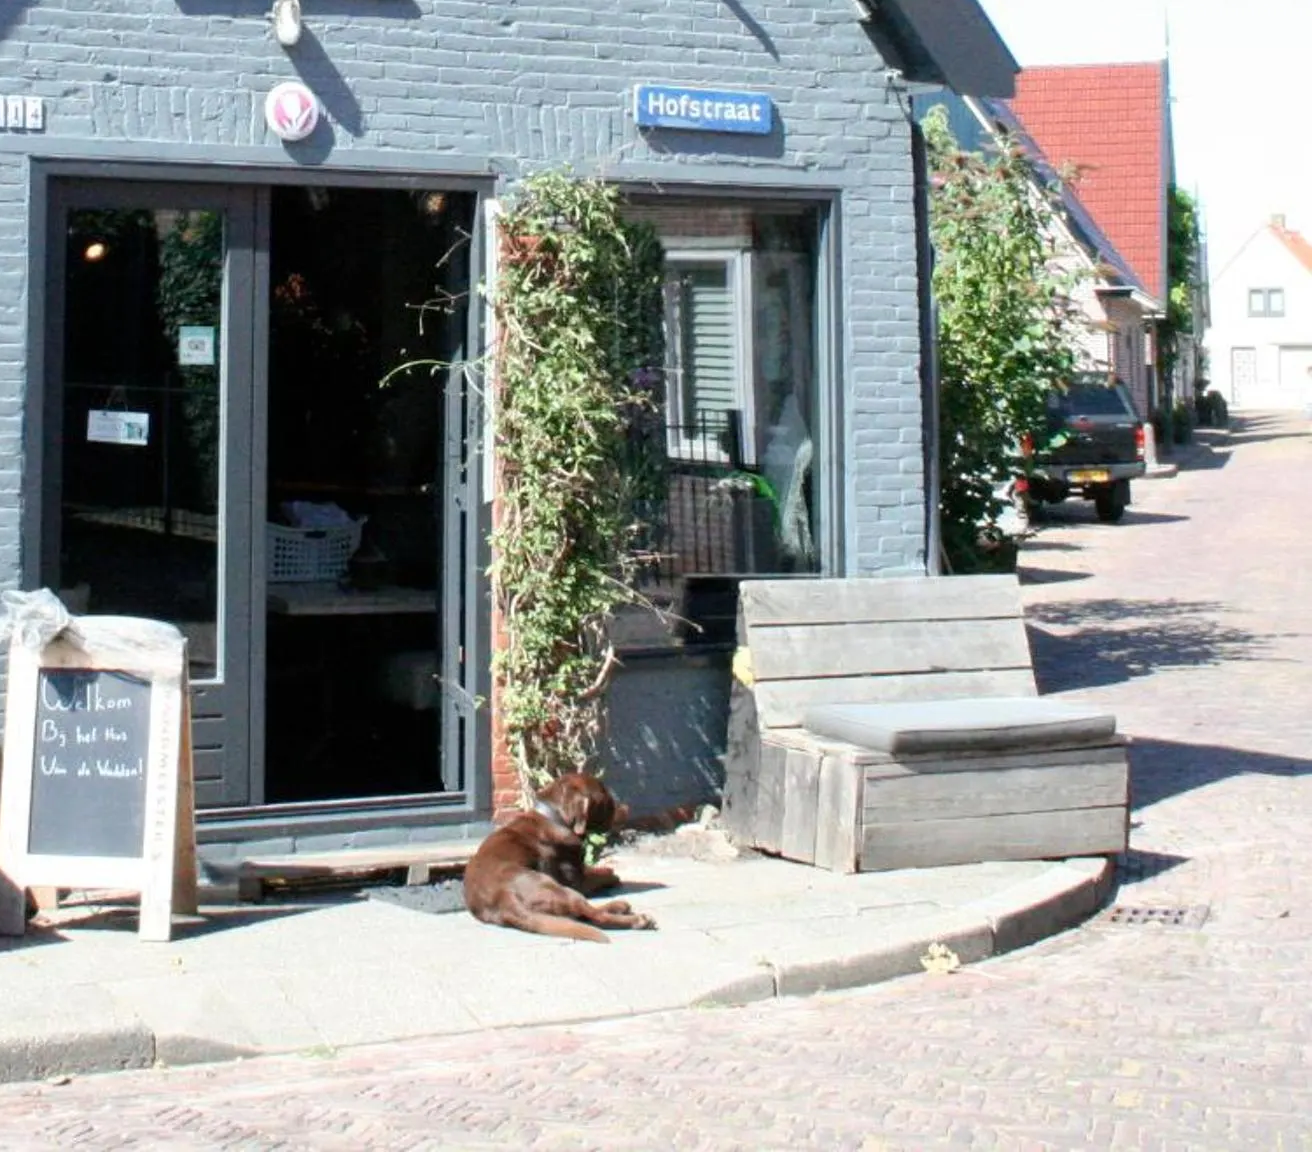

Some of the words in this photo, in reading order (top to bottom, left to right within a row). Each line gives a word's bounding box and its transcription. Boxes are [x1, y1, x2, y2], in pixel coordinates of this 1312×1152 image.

[647, 92, 761, 122] Hofstraat
[40, 675, 133, 713] Welkom
[76, 725, 97, 744] het
